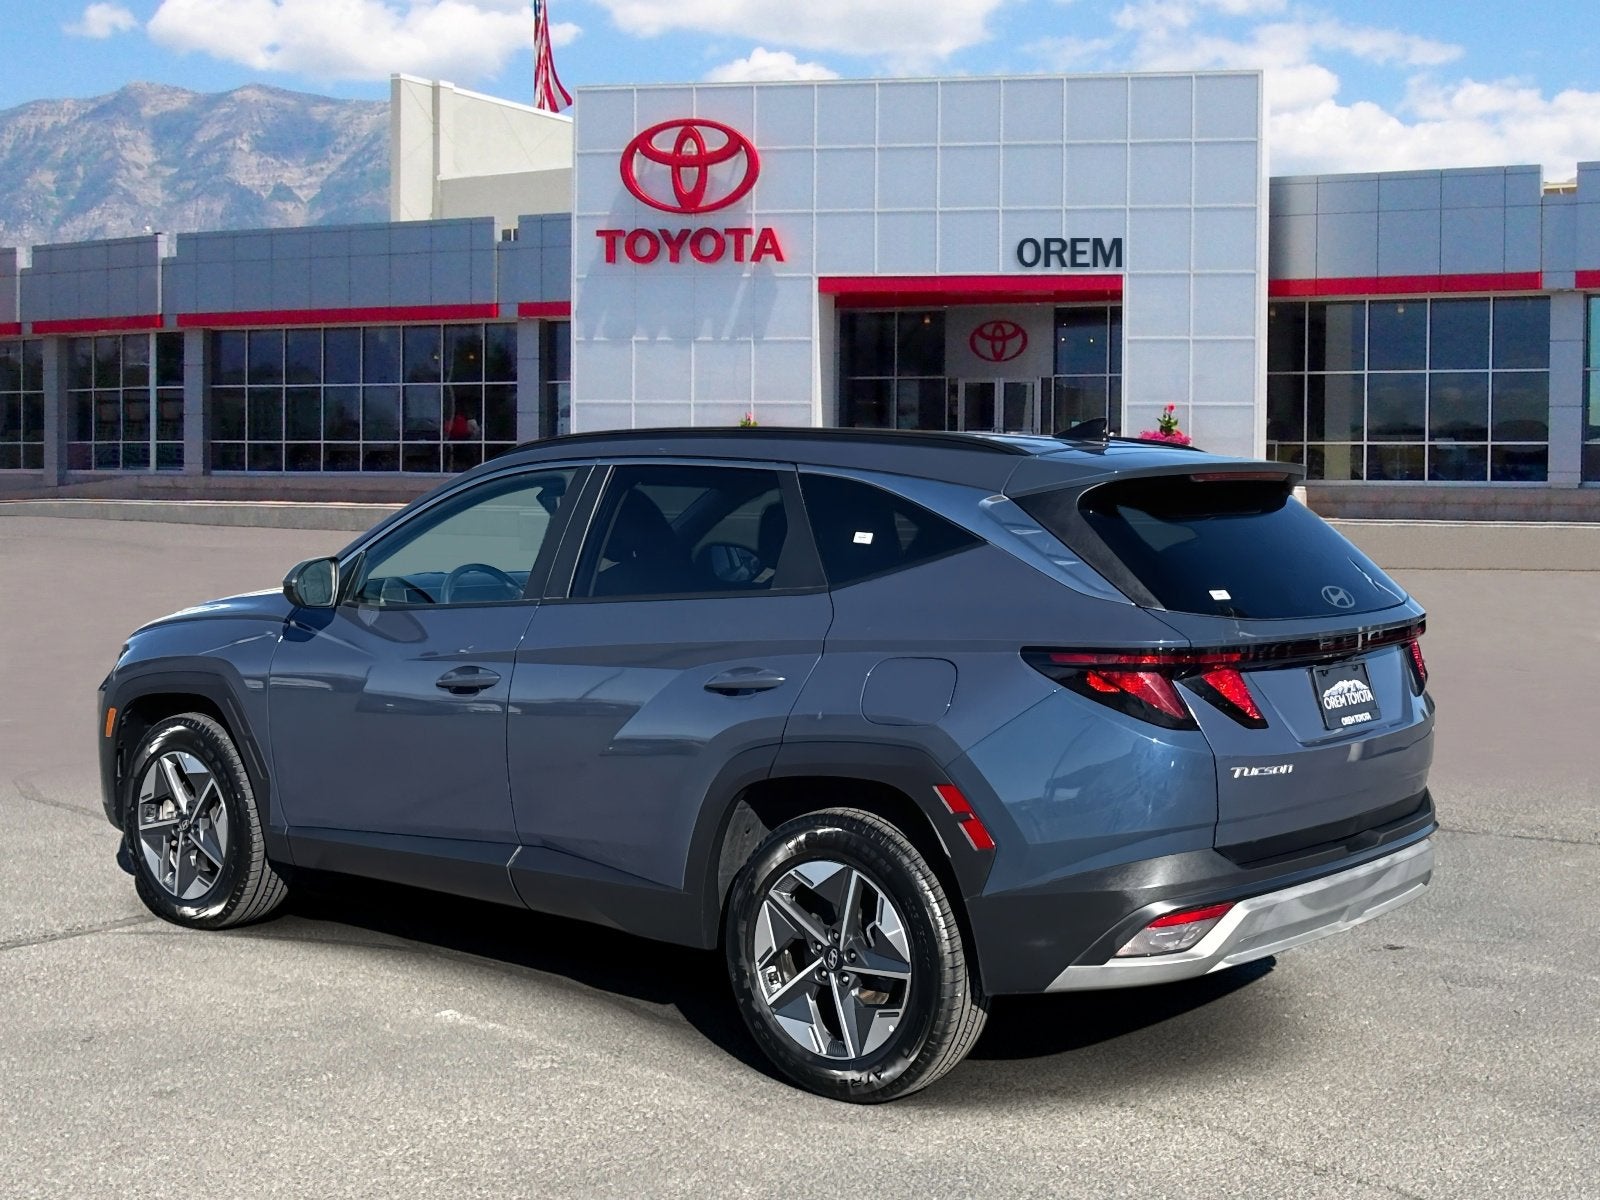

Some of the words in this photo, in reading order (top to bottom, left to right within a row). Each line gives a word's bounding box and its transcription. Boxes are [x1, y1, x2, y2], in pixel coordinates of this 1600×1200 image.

[596, 227, 784, 264] TOYOTA
[1016, 237, 1123, 268] OREM
[1324, 694, 1347, 709] OREM
[1346, 690, 1373, 705] TOYOTA
